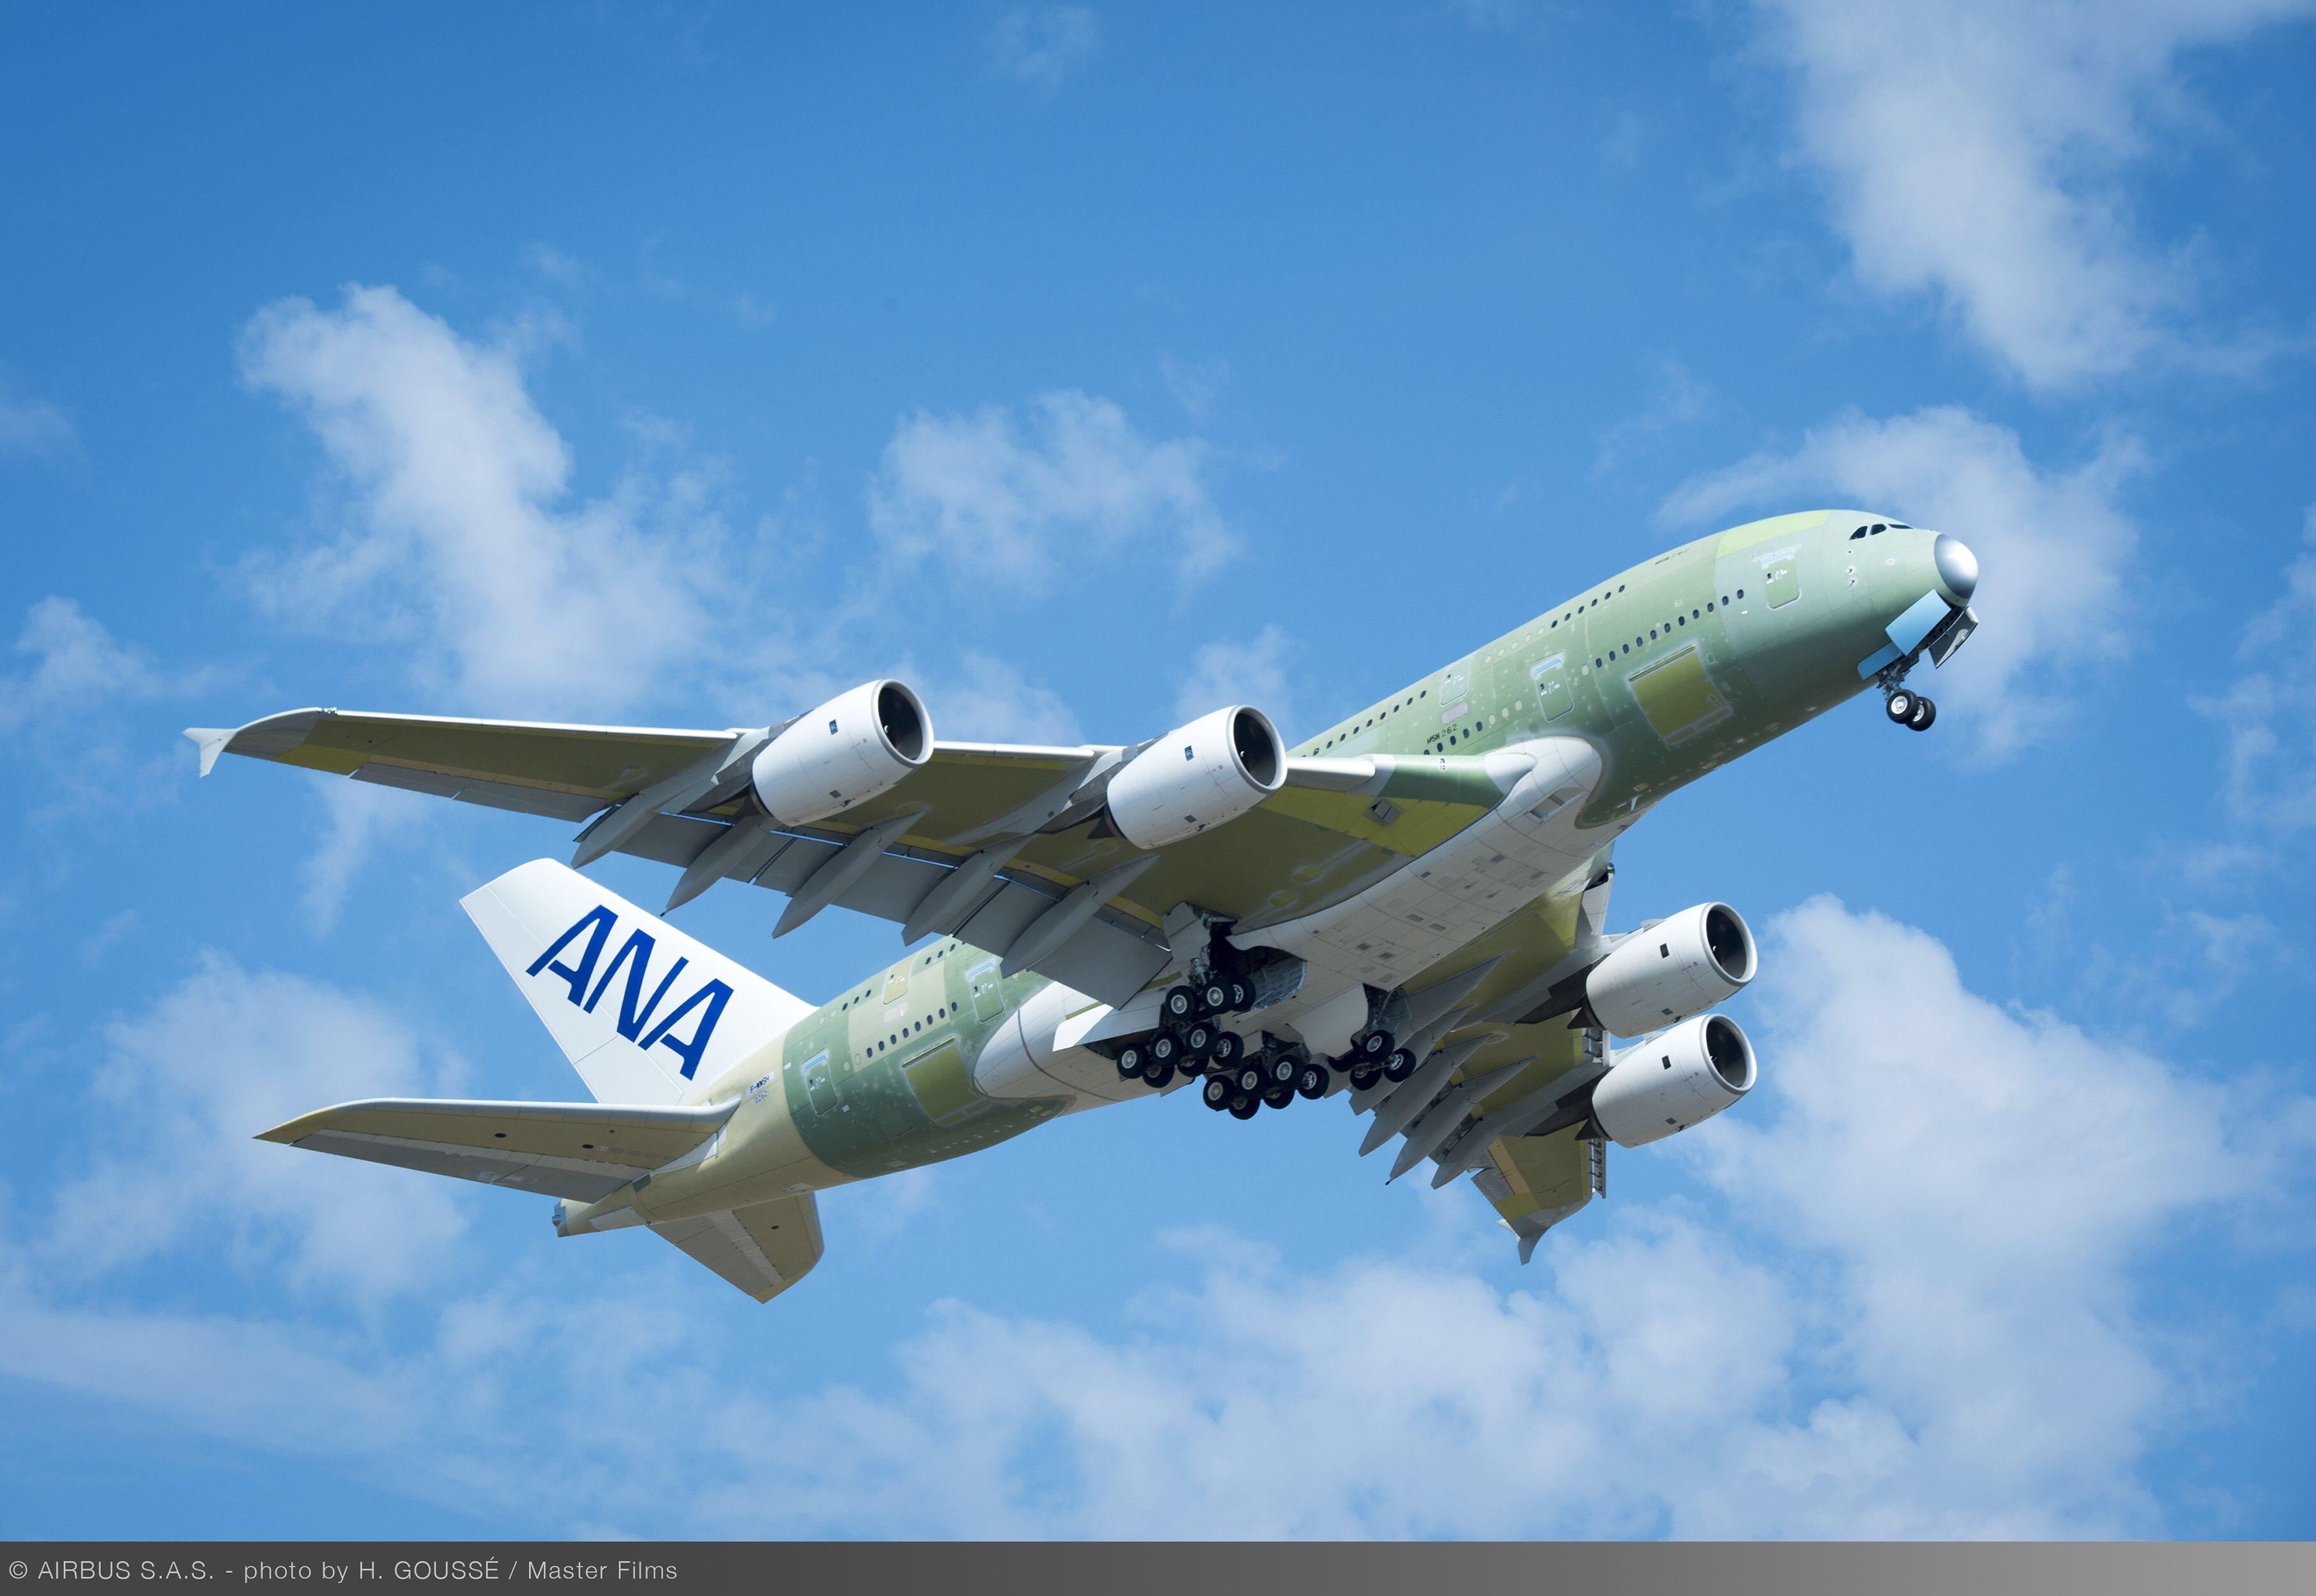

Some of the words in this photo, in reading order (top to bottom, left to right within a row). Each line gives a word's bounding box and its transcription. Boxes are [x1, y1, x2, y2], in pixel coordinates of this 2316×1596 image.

[1426, 733, 1440, 745] MSN
[1441, 723, 1458, 738] 262
[526, 904, 734, 1081] ANA
